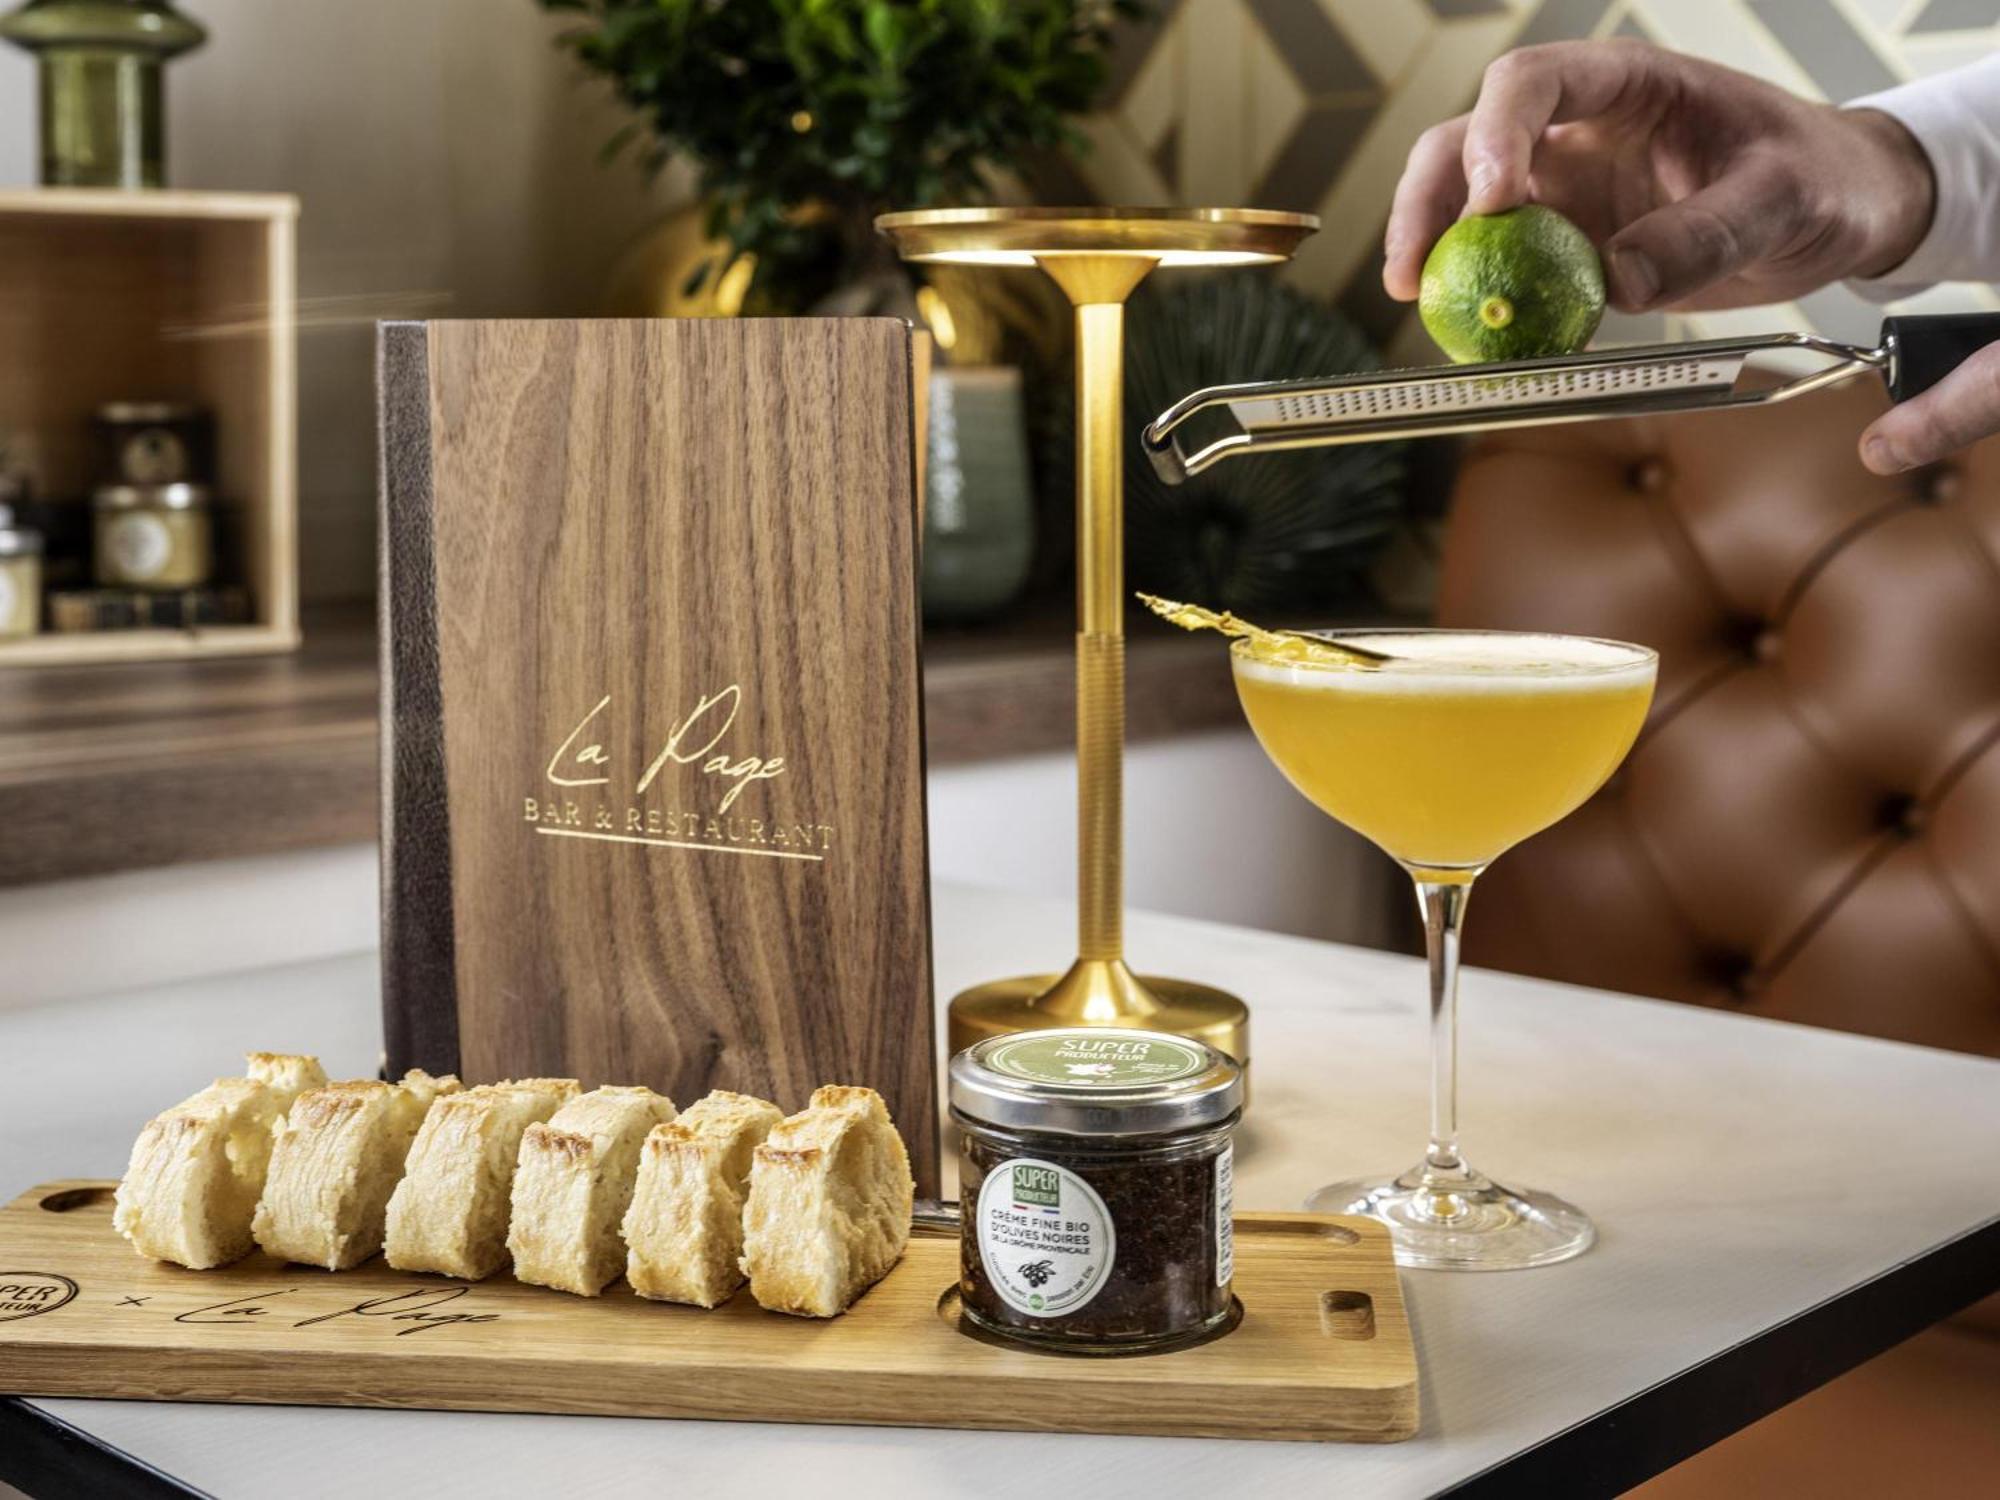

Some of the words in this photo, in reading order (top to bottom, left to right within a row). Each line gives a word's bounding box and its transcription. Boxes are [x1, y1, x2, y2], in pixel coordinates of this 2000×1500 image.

[547, 694, 610, 787] La
[637, 684, 786, 815] Page
[524, 797, 582, 826] BAR
[595, 805, 614, 829] &
[626, 807, 835, 850] RESTAURANT
[1061, 1039, 1152, 1055] SUPER
[1014, 1166, 1058, 1191] SUPER
[1031, 1217, 1062, 1232] FINE
[1065, 1221, 1090, 1233] BIO
[1041, 1232, 1091, 1245] NOIRES
[0, 1284, 59, 1301] PER
[293, 1286, 502, 1336] Page
